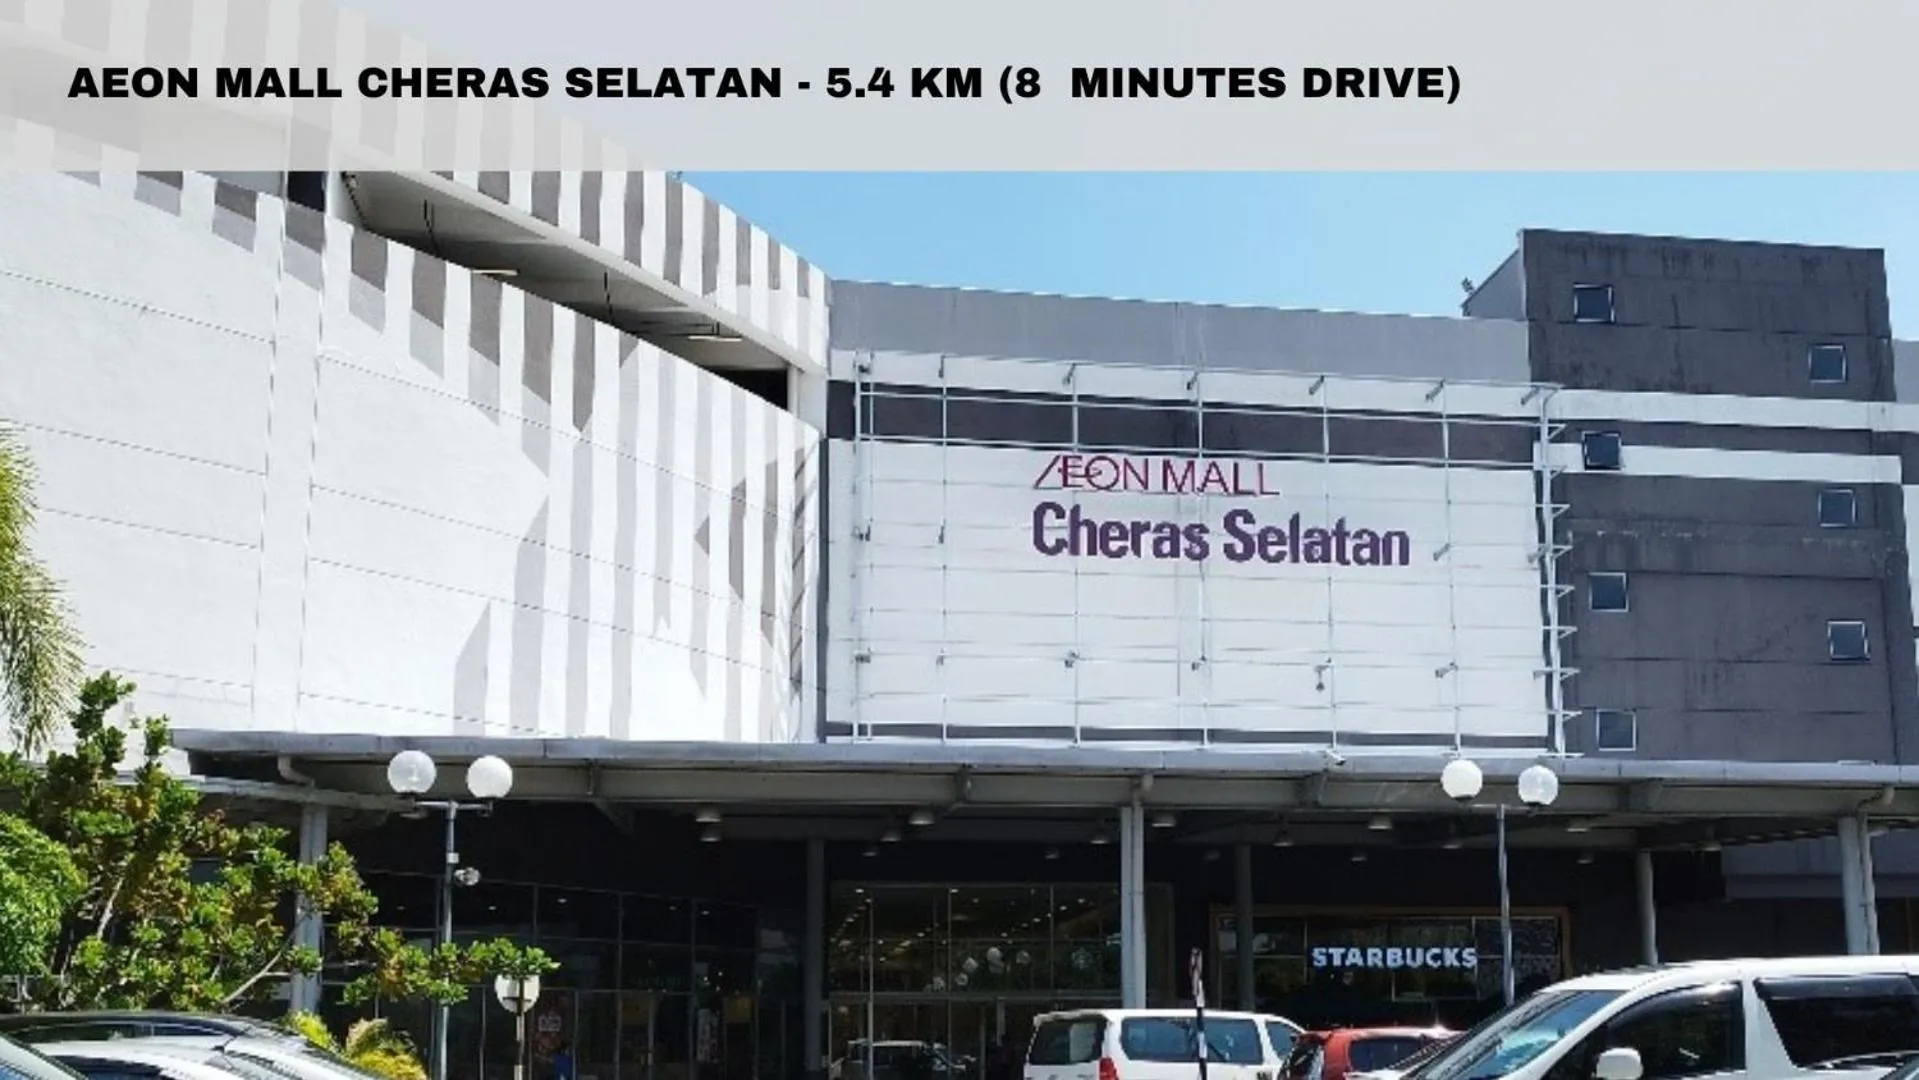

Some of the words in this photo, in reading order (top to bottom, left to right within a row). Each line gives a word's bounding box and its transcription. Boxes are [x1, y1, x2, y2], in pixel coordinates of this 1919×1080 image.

[1161, 458, 1280, 496] MALL
[1033, 501, 1210, 561] Cheras
[1223, 508, 1410, 566] Selatan
[1312, 947, 1478, 968] STARBUCKS
